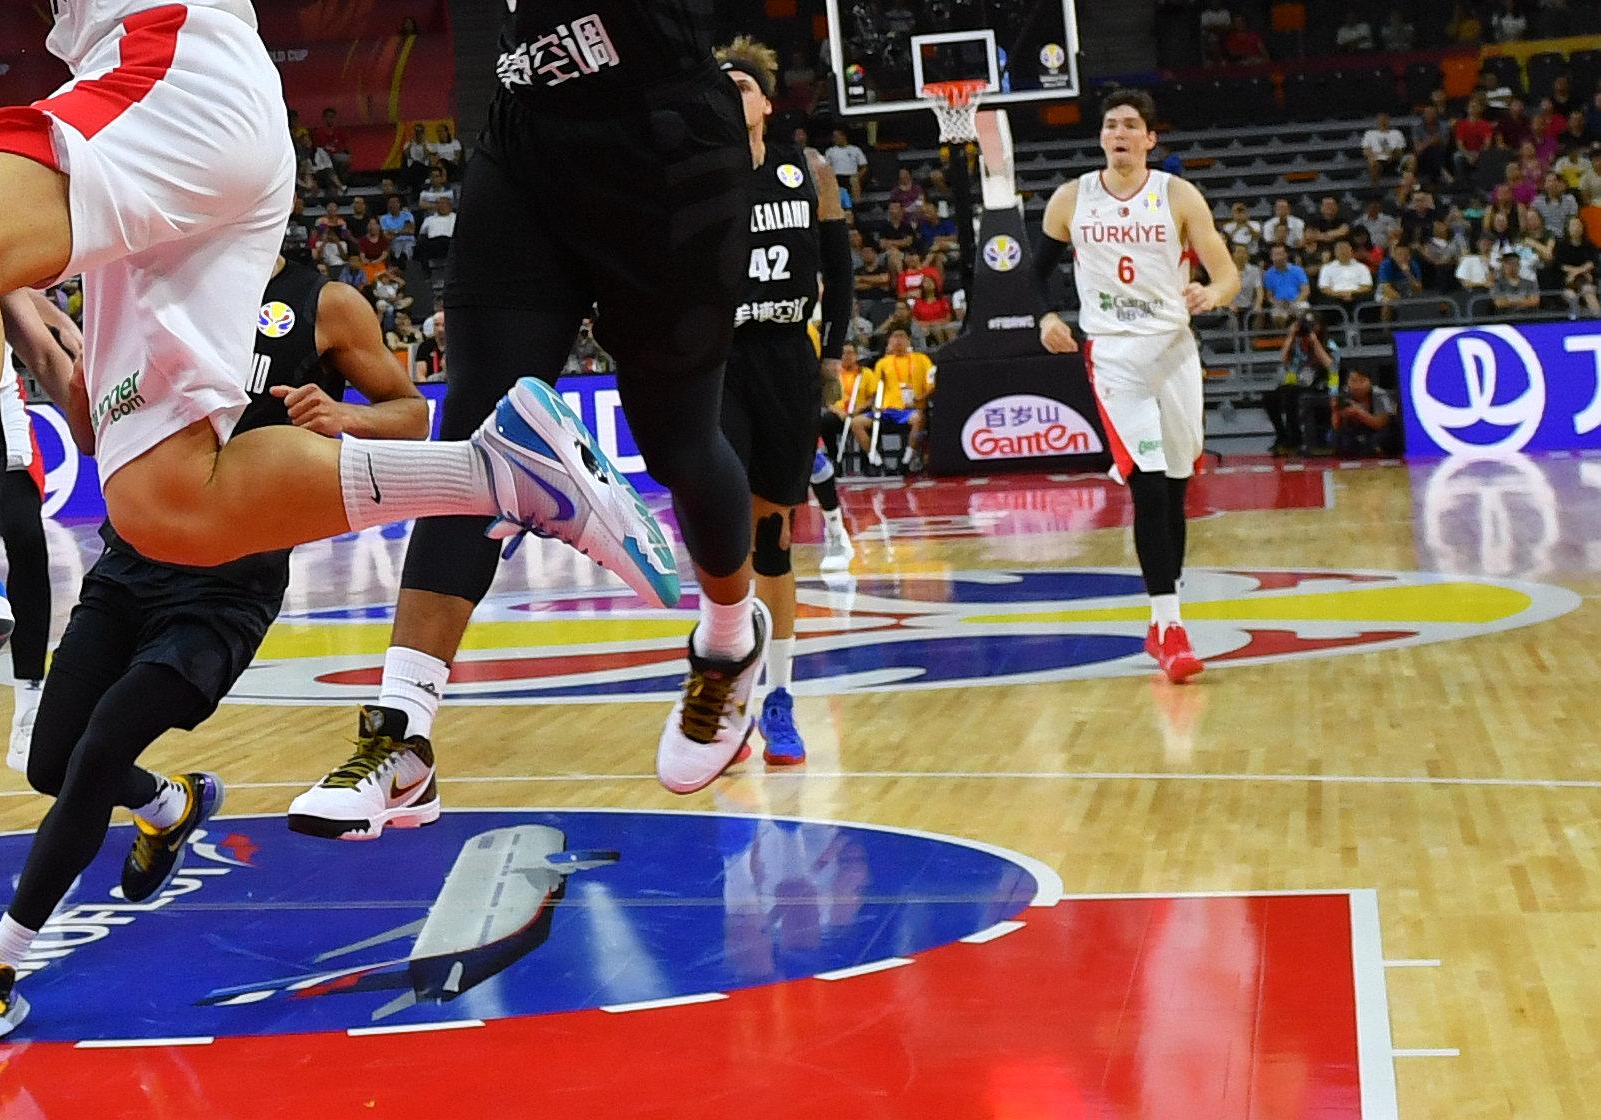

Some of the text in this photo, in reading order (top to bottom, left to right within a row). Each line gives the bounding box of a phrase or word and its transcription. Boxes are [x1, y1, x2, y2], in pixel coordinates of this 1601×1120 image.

[1079, 221, 1167, 243] TÜRKİYE
[748, 244, 791, 282] 42
[1118, 255, 1136, 285] 6
[984, 404, 1059, 428] 百岁山
